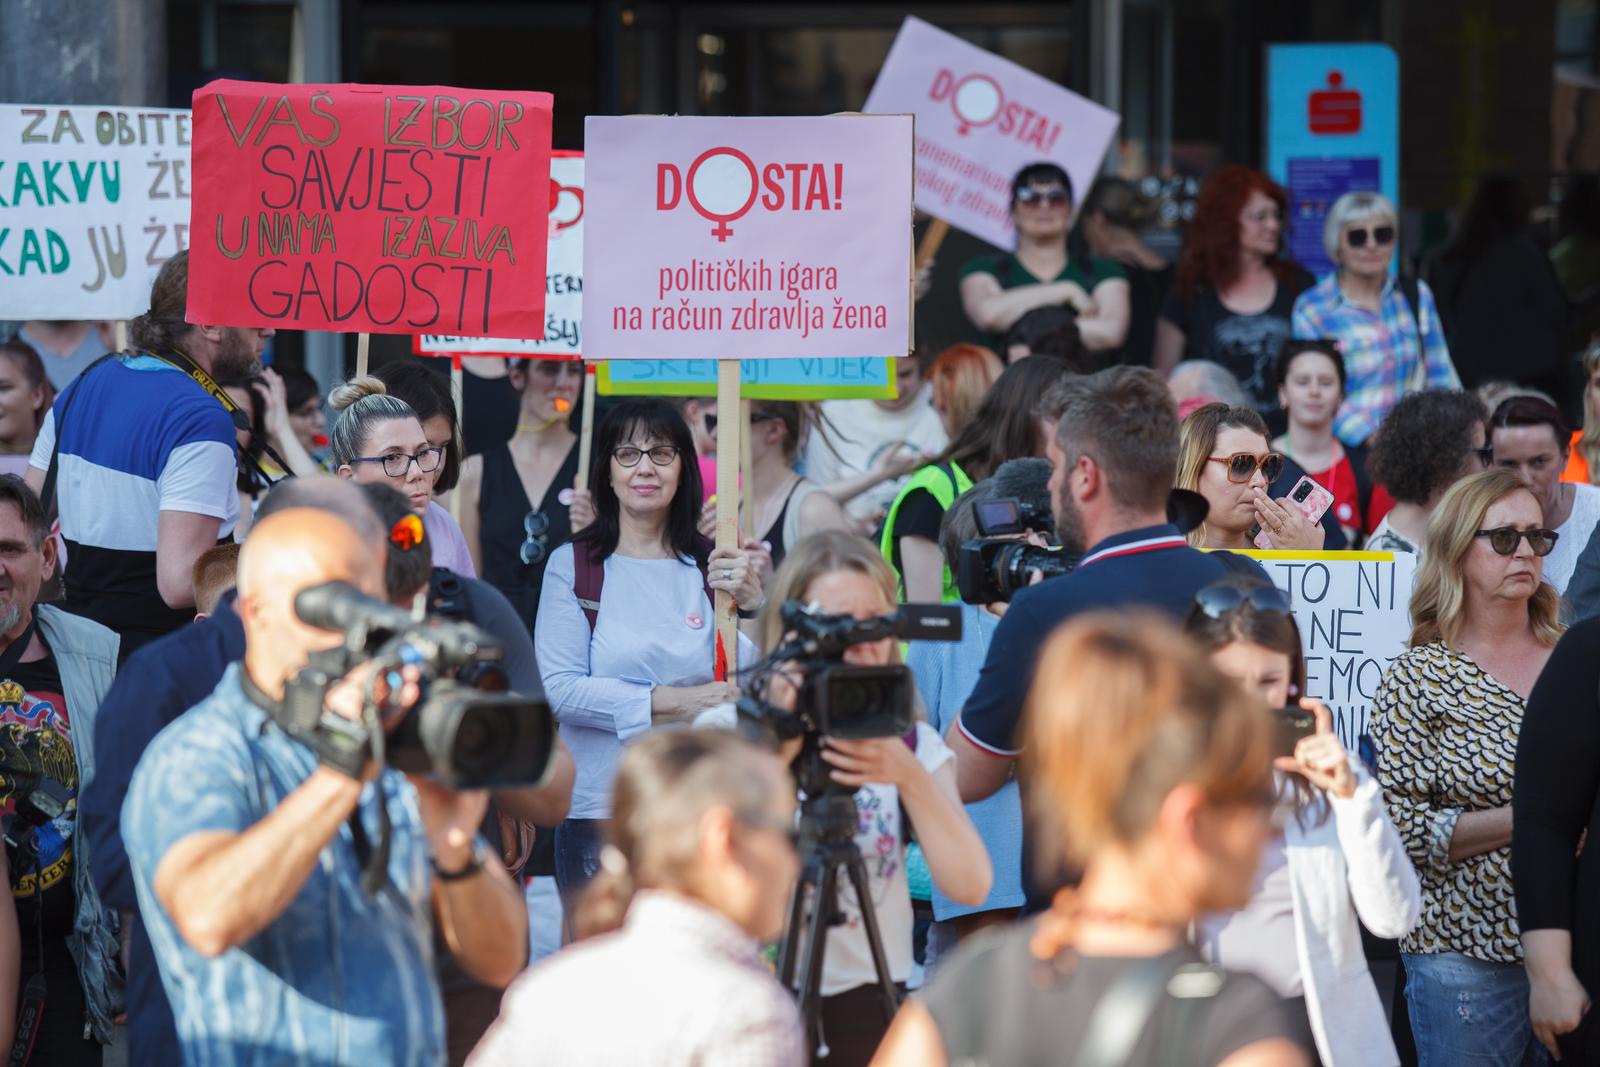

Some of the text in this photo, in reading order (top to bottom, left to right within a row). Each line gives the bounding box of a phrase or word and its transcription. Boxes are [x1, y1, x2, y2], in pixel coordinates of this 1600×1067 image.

[21, 109, 84, 144] ZA
[215, 90, 525, 151] VAŠ IZBOR
[929, 68, 1062, 152] DOSTA!
[261, 144, 492, 217] SAVJESTI
[656, 146, 844, 242] DOSTA!
[81, 224, 127, 293] JU
[215, 213, 517, 266] U NAMA IZAZIVA
[249, 260, 493, 334] GADOSTI
[659, 258, 838, 300] političkih igara
[613, 297, 887, 338] na račun zdravlja žena
[1257, 559, 1396, 610] TO NI
[1310, 608, 1364, 654] NE
[1304, 656, 1394, 702] EMO
